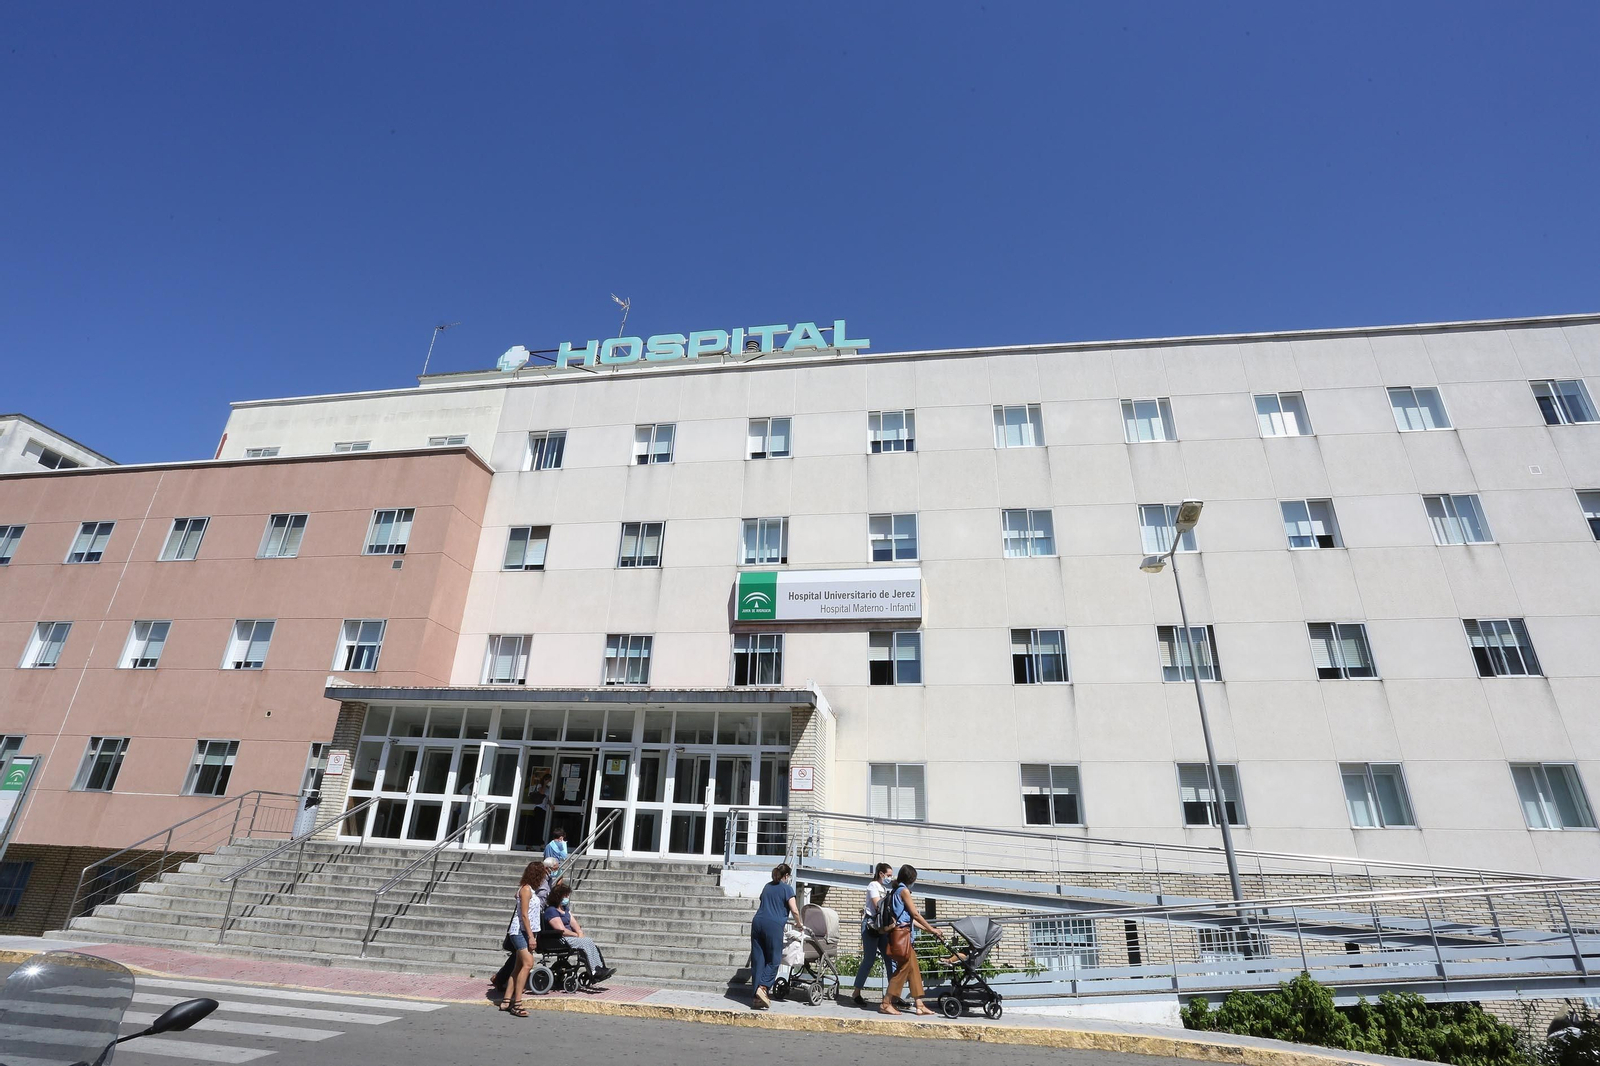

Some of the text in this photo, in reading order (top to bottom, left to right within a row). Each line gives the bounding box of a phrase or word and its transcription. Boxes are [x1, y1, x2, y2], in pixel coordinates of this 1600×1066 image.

[556, 320, 870, 369] HOSPITAL
[788, 589, 916, 602] Hospital Universitario de Jerez
[820, 604, 851, 615] Hospital
[852, 603, 884, 613] Materno
[890, 602, 916, 612] Infantil
